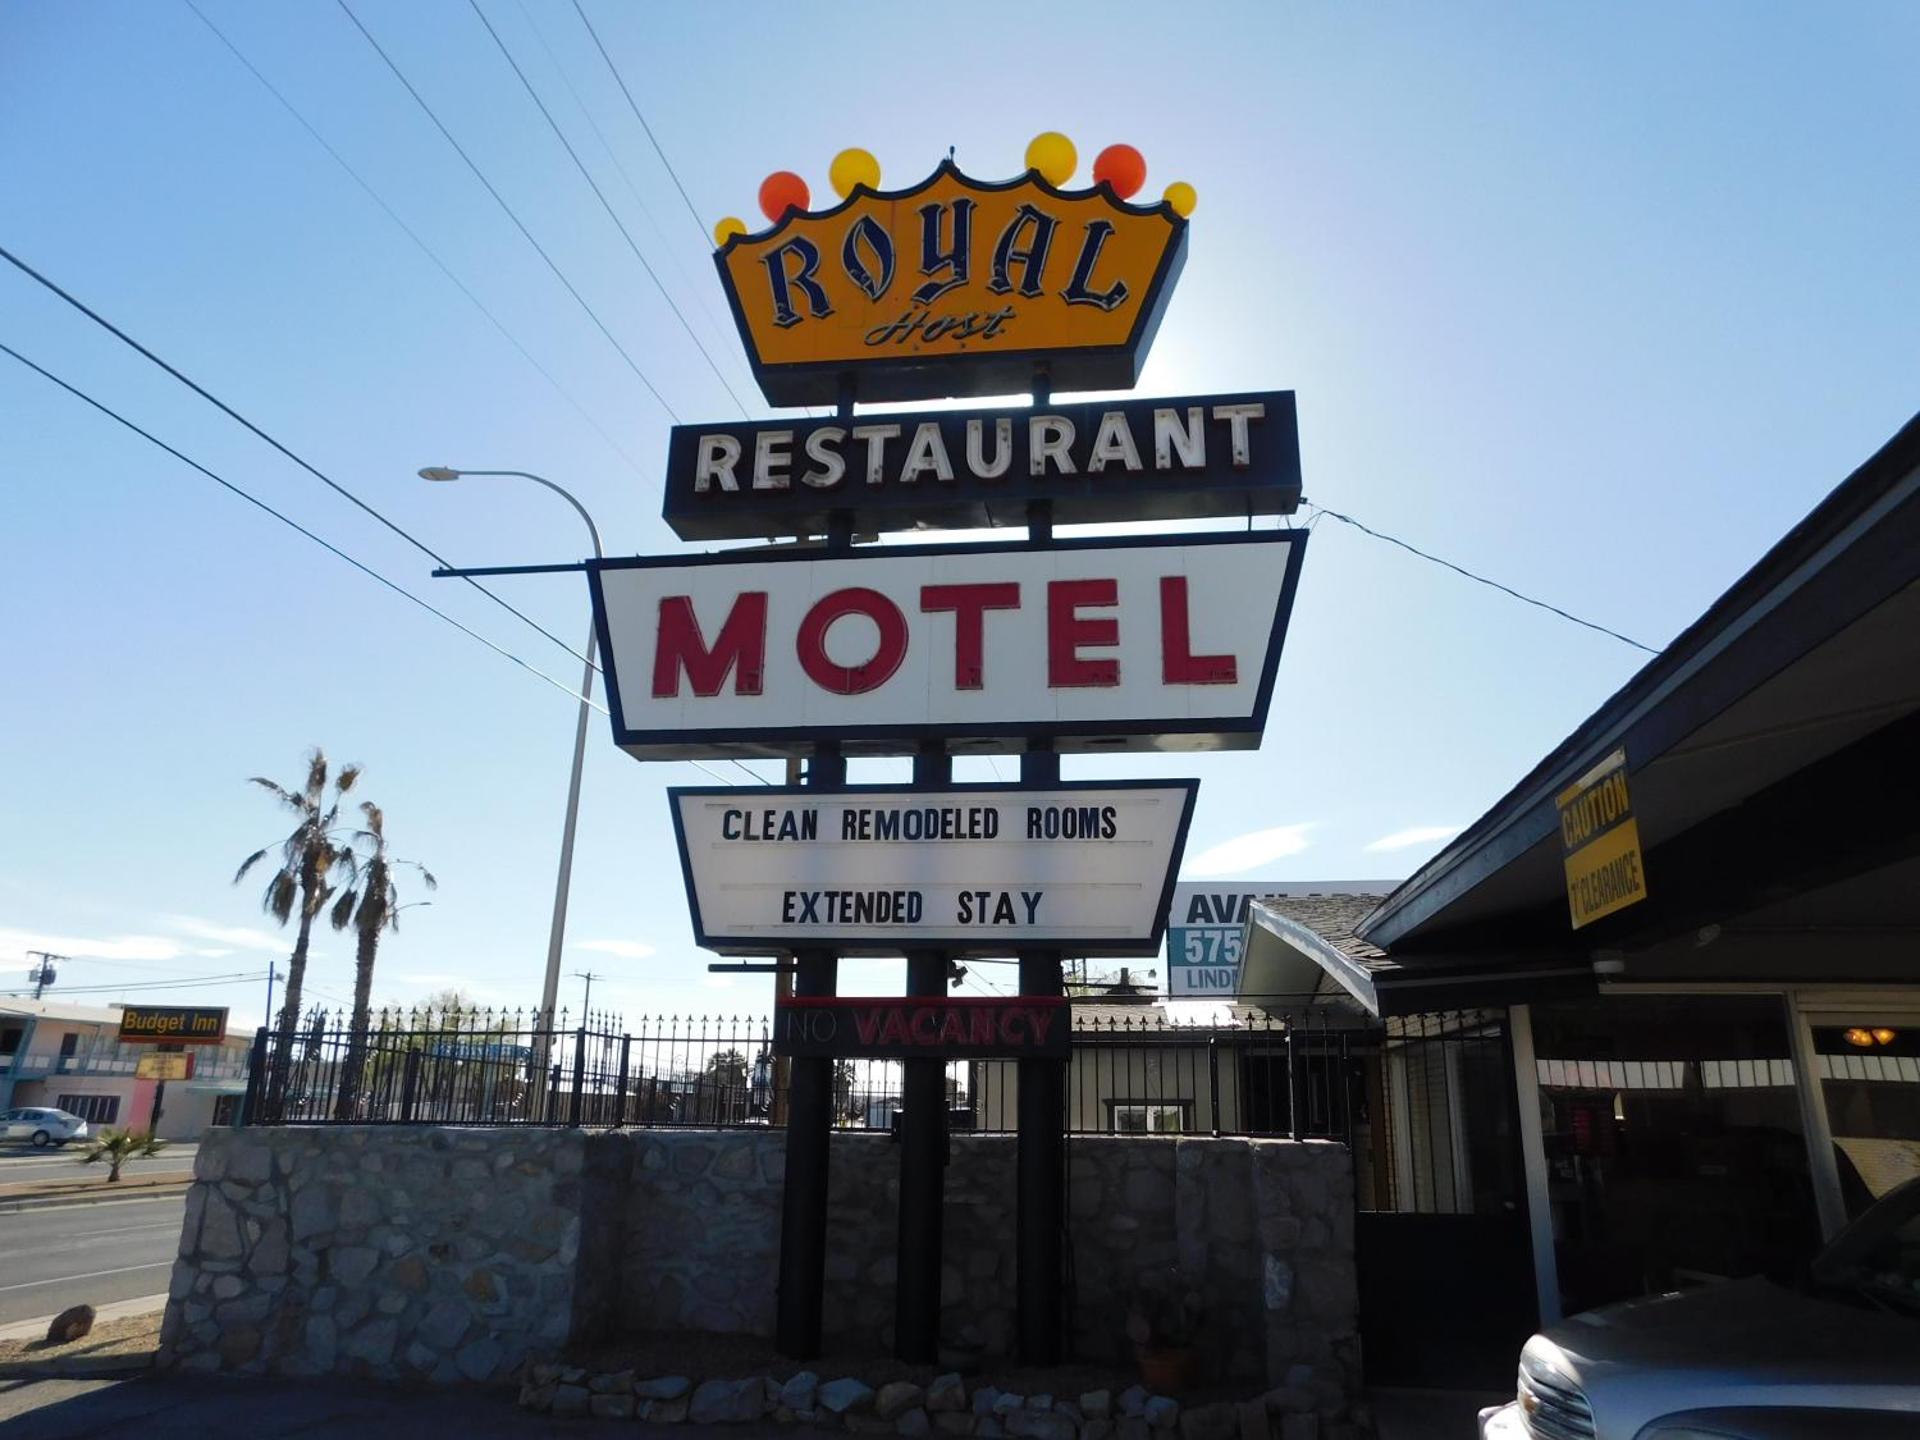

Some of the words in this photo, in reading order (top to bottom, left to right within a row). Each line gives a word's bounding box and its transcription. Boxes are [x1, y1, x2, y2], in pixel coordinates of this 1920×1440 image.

[759, 198, 1130, 328] ROYAL
[863, 305, 1017, 347] Host
[694, 403, 1267, 493] RESTAURANT
[652, 576, 1238, 698] MOTEL
[722, 808, 818, 842] CLEAN
[841, 807, 999, 841] REMODELED
[1026, 806, 1118, 840] ROOMS
[1562, 769, 1630, 849] CAUTION
[1581, 850, 1641, 915] CLEARANCE
[782, 891, 923, 924] EXTENDED
[957, 891, 1044, 925] STAY
[1185, 930, 1242, 964] 575
[124, 1011, 186, 1034] Budget
[192, 1013, 219, 1032] Inn
[785, 1010, 838, 1043] NO
[853, 1007, 1057, 1046] VACANCY
